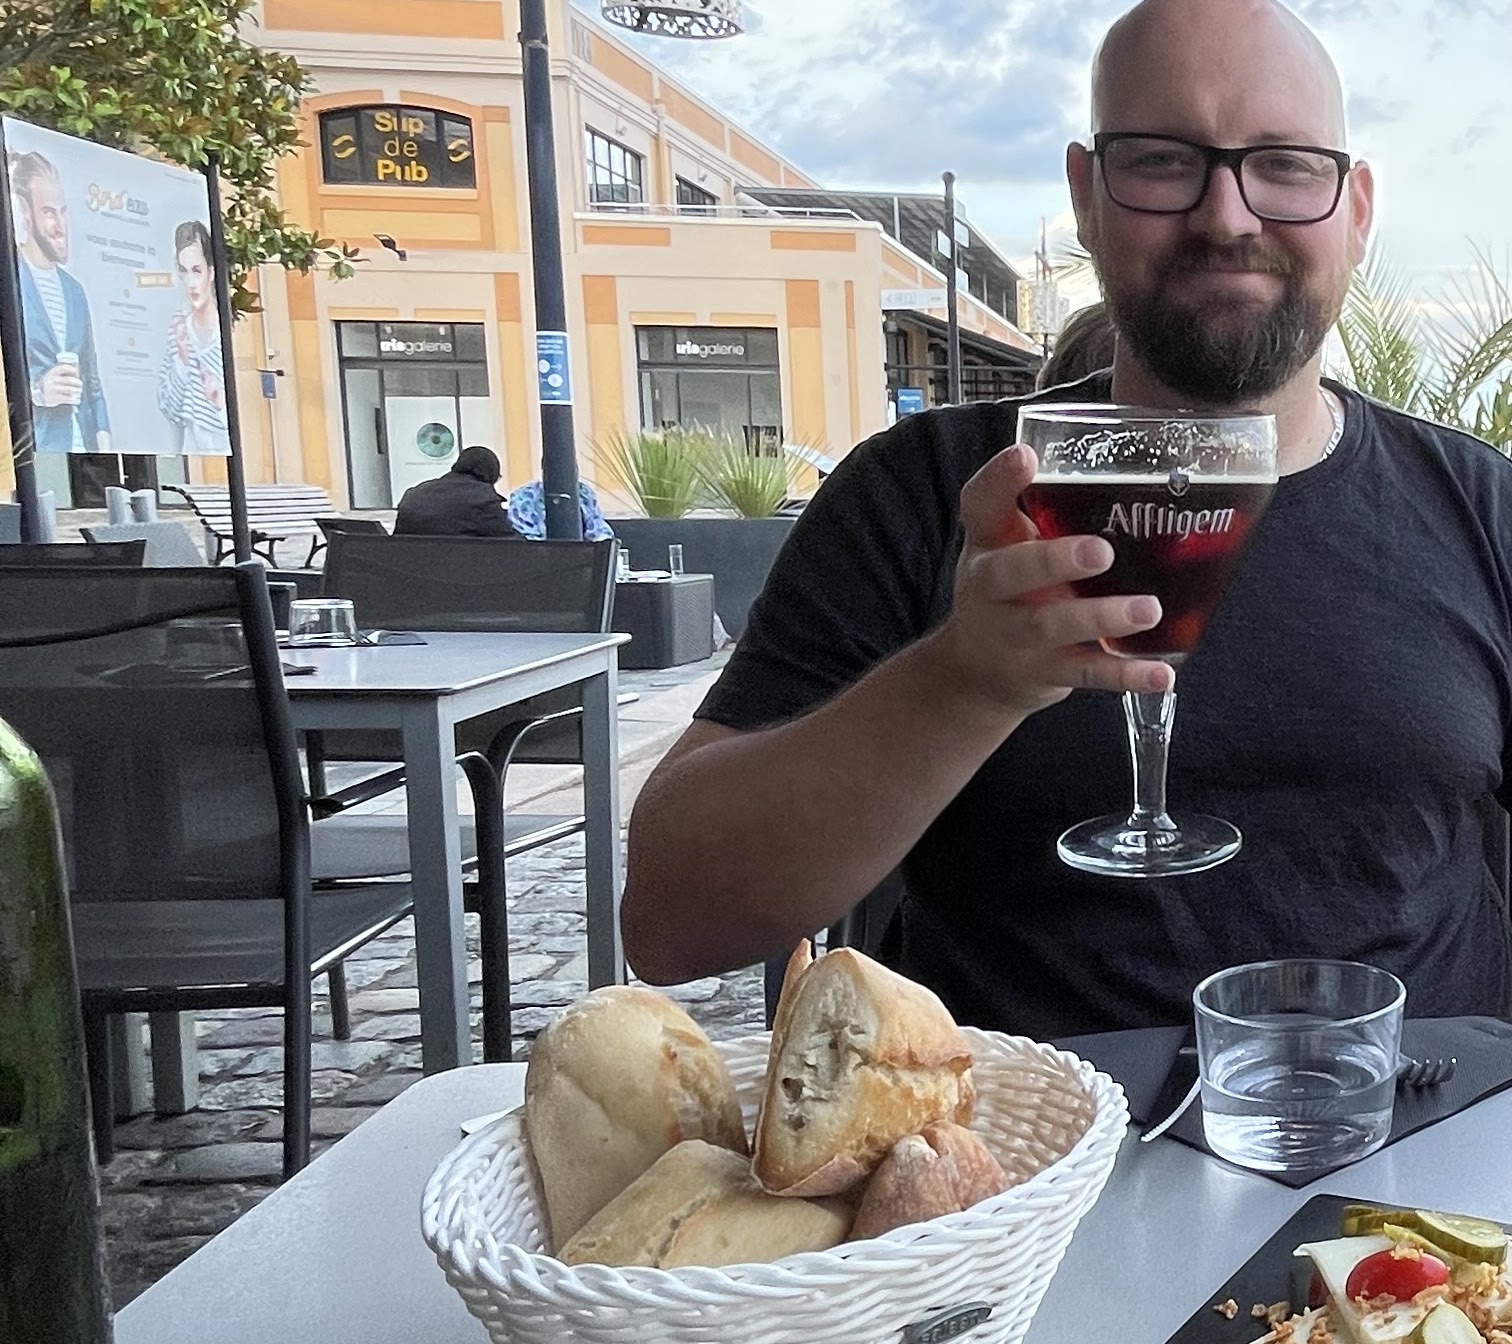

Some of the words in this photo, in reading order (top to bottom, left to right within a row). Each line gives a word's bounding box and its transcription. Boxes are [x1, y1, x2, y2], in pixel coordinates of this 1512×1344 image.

[374, 111, 425, 137] Sup
[383, 136, 418, 158] de
[376, 159, 429, 182] Pub
[1101, 502, 1236, 541] Affligem
